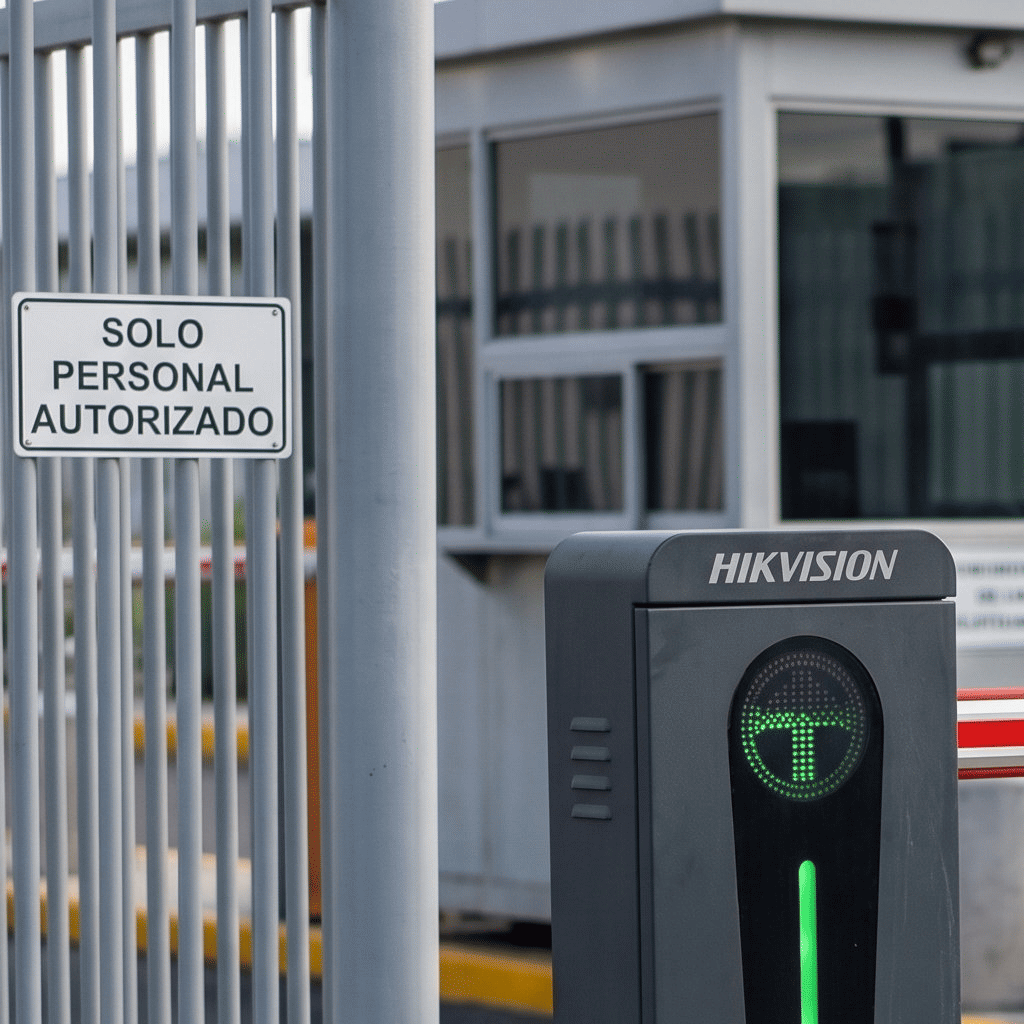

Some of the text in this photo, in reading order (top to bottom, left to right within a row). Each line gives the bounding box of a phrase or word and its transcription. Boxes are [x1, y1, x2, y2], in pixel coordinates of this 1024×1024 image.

[102, 317, 204, 349] SOLO
[53, 360, 254, 392] PERSONAL
[31, 404, 274, 436] AUTORIZADO
[709, 550, 898, 584] HIKVISION
